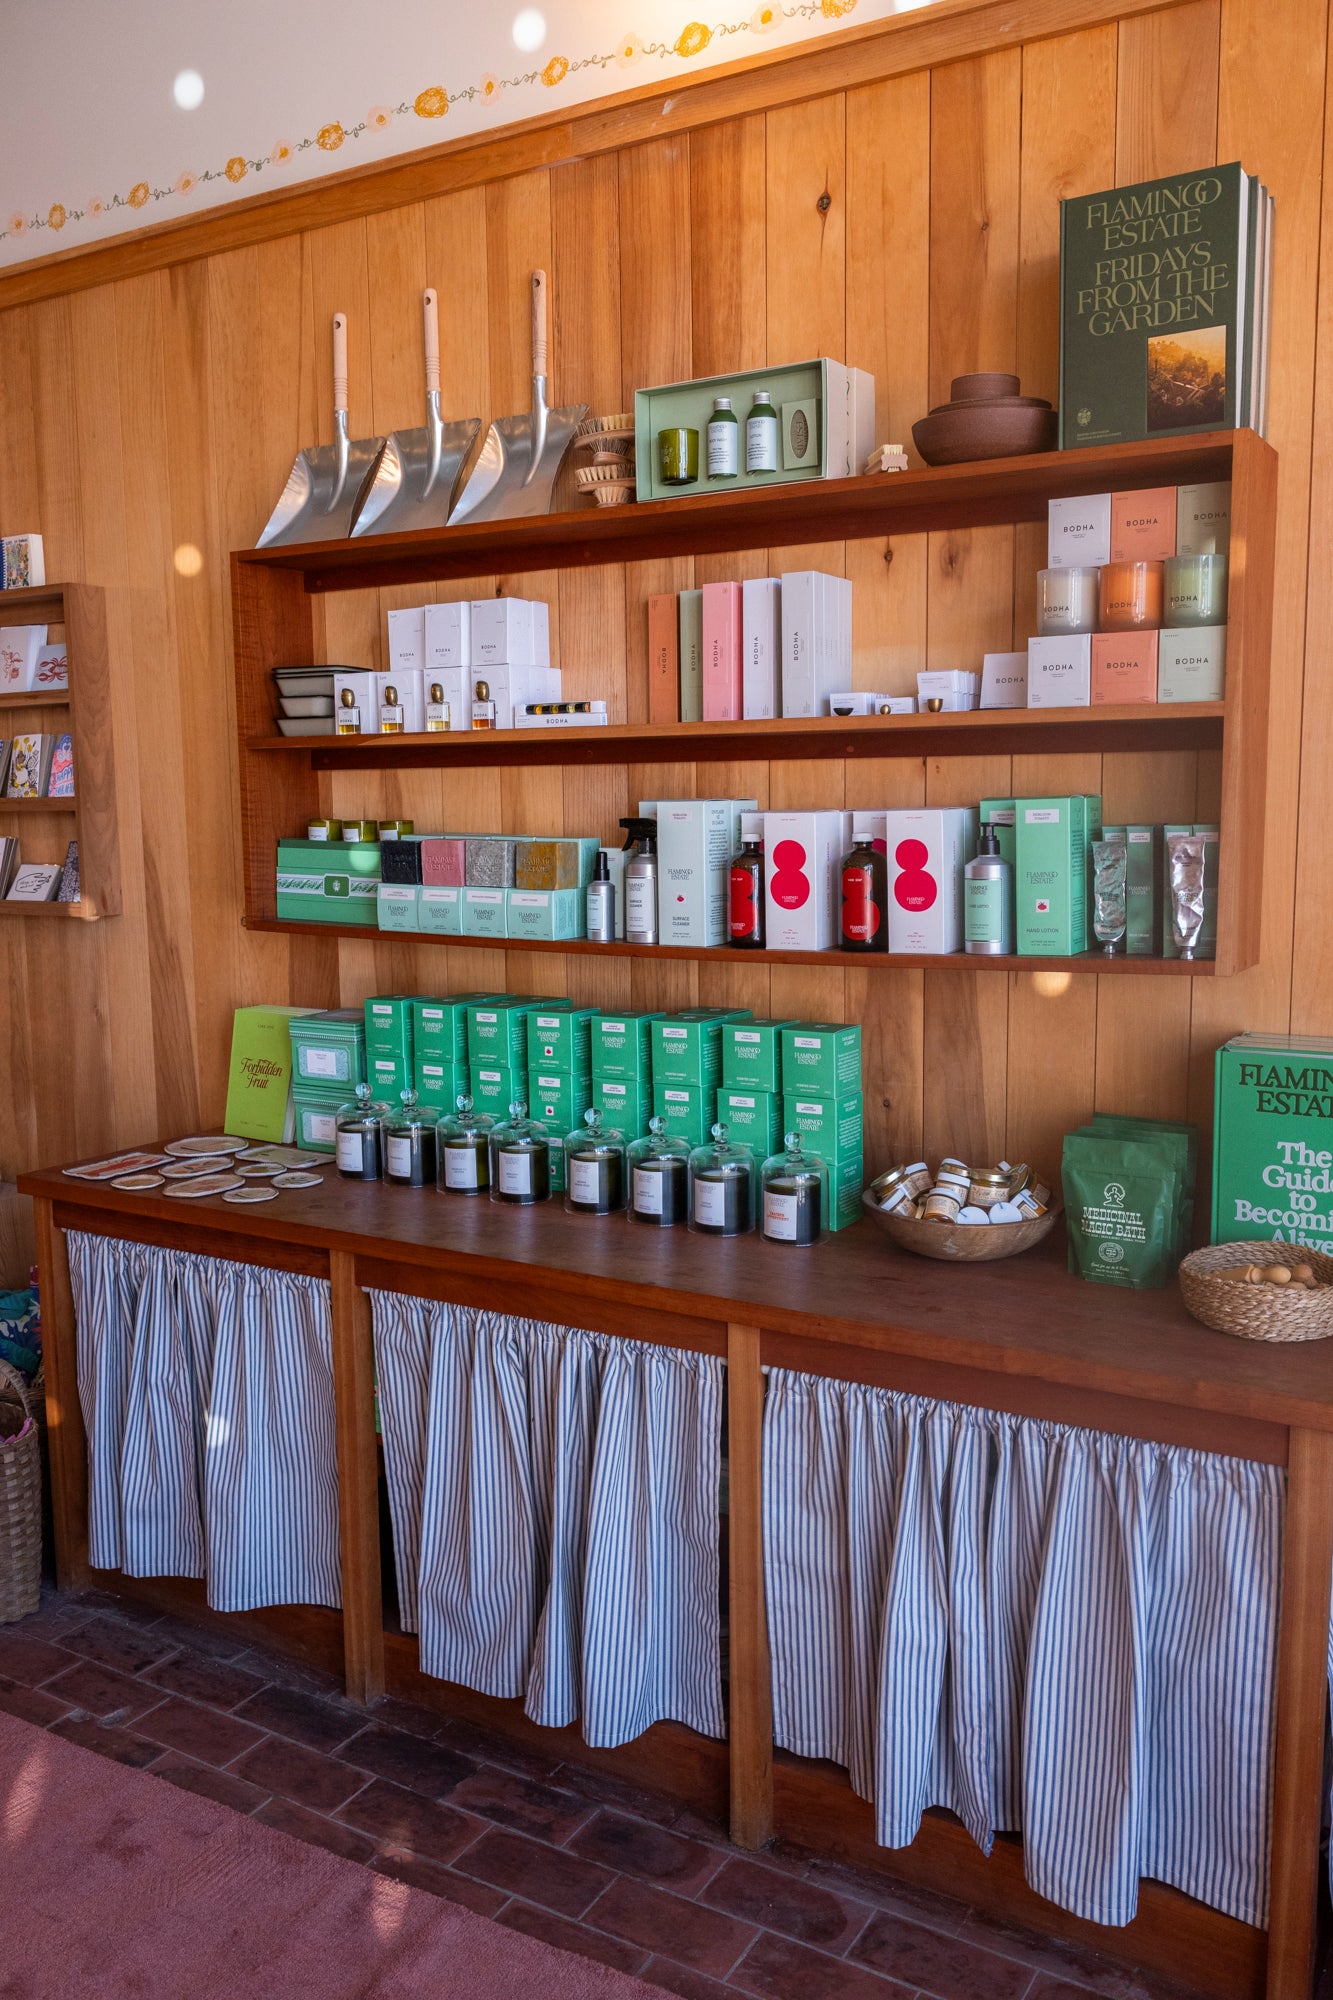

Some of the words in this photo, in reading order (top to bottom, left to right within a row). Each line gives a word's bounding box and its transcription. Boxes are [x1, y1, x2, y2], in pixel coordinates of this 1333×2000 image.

[1086, 177, 1222, 229] FLAMINGO
[1104, 208, 1202, 251] ESTATE
[1095, 240, 1211, 286] FRIDAYS
[1077, 276, 1160, 315] FROM
[1167, 263, 1230, 297] THE
[1088, 291, 1216, 337] GARDEN
[1193, 511, 1228, 521] BODHA
[1126, 517, 1159, 527] BODHA
[1063, 523, 1094, 533] BODHA
[1106, 661, 1139, 670] BODHA
[1175, 656, 1209, 665] BODHA
[1042, 663, 1074, 672] BODHA
[546, 717, 569, 725] BODHA
[1026, 871, 1058, 879] FLAMINGO
[602, 1036, 626, 1044] FLAMINGO
[734, 1046, 760, 1054] FLAMINGO
[794, 1052, 821, 1060] FLAMINGO
[240, 1057, 283, 1077] Forbidden
[797, 1058, 817, 1066] ESTATE
[247, 1073, 270, 1089] Fruit
[796, 1118, 823, 1126] FLAMINGO
[1276, 1141, 1332, 1168] The
[1262, 1165, 1333, 1193] Guid
[1289, 1191, 1317, 1211] to
[1083, 1206, 1143, 1225] MEDICINAL
[1081, 1219, 1113, 1235] MAGIC
[1116, 1224, 1146, 1239] BATH
